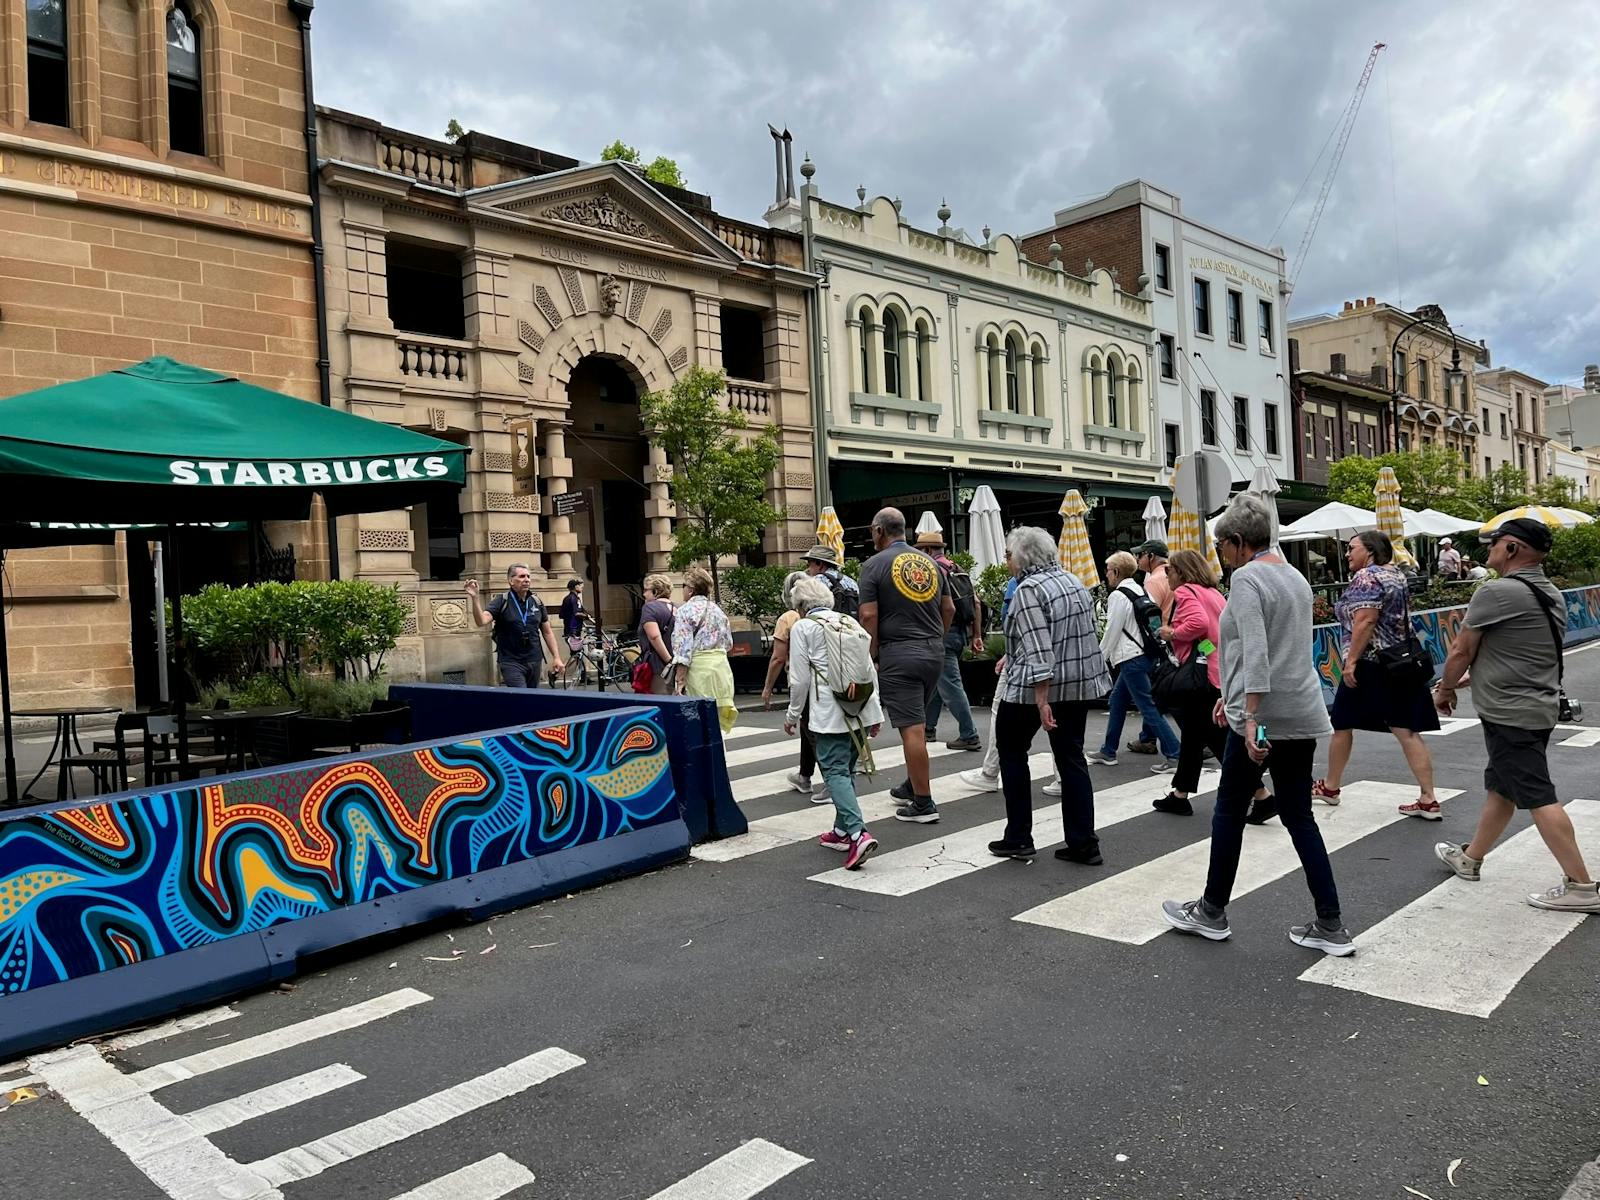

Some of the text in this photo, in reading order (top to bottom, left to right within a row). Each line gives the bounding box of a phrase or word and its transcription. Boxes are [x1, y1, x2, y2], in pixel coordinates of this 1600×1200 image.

[36, 158, 209, 210] CHARTERED
[540, 245, 668, 282] POLICE STATION
[169, 456, 449, 485] STARBUCKS
[43, 821, 57, 833] The
[56, 827, 76, 845] Rocks
